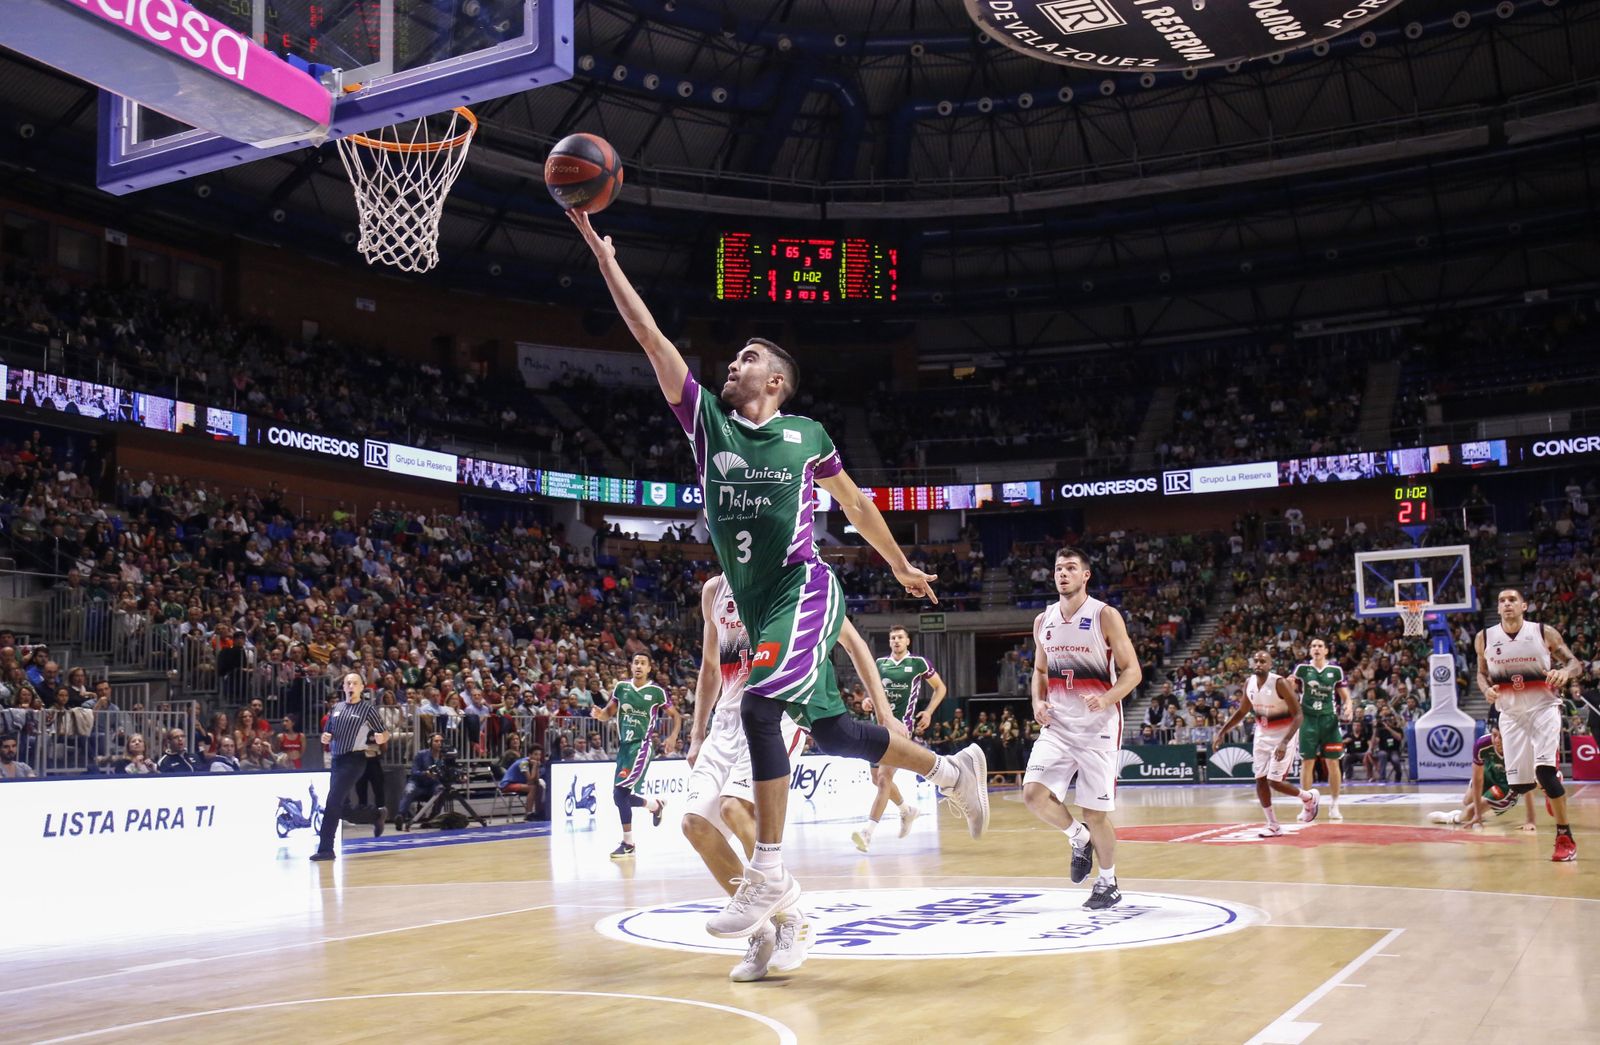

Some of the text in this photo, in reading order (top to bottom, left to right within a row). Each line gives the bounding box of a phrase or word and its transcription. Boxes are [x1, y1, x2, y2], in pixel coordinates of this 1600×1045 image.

[1323, 0, 1390, 29] POR
[1141, 6, 1216, 62] RESERVA
[785, 246, 799, 258] 65
[819, 248, 832, 260] 56
[804, 257, 811, 267] 3
[793, 271, 821, 283] 01:02
[785, 289, 792, 299] 3
[823, 291, 830, 300] 5
[267, 426, 359, 460] CONGRESOS
[395, 454, 416, 467] Grupo
[416, 458, 425, 468] La
[426, 459, 452, 473] Reserva
[1532, 436, 1600, 457] CONGR
[744, 466, 792, 482] Unicaja
[1061, 477, 1158, 499] CONGRESOS
[1200, 476, 1224, 486] Grupo
[1226, 474, 1236, 482] La
[1238, 471, 1271, 481] Reserva
[1394, 486, 1427, 500] 01:02
[682, 487, 703, 504] 65
[718, 485, 772, 515] Málaga
[1398, 501, 1427, 524] 21
[735, 530, 753, 565] 3
[725, 620, 742, 630] TEC
[752, 650, 770, 661] en
[1061, 669, 1074, 690] 7
[1139, 762, 1194, 778] Unicaja
[1419, 760, 1446, 769] Málaga
[639, 777, 684, 796] ENEMOS
[43, 805, 216, 838] LISTA PARA TI
